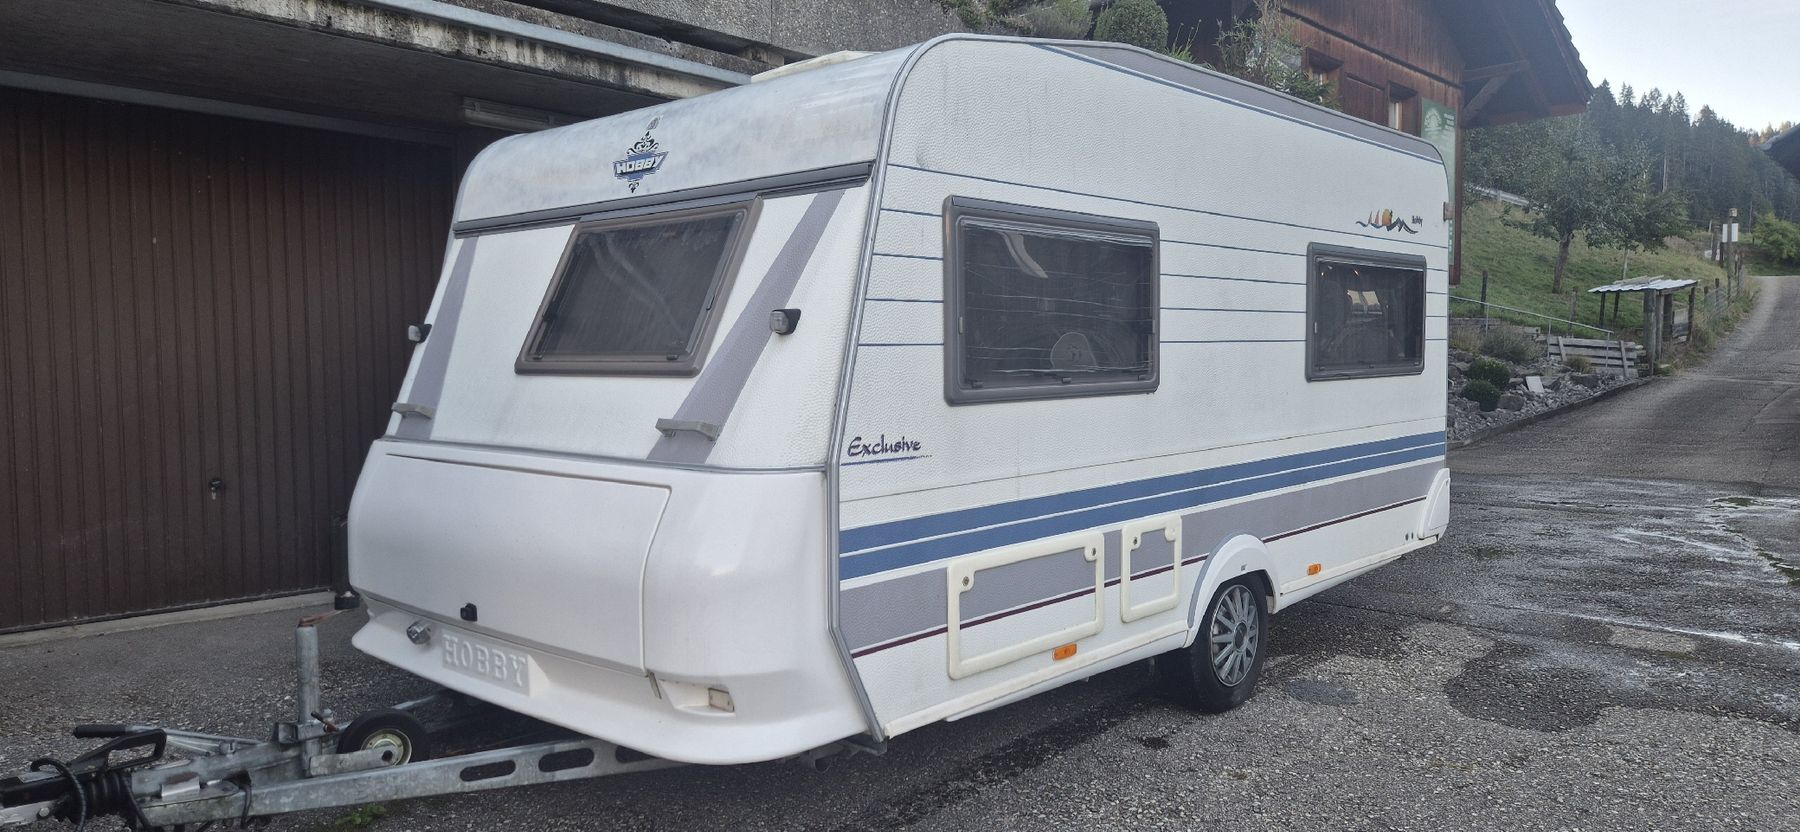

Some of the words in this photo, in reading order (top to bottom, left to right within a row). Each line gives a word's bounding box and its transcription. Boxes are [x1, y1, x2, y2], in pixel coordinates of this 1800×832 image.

[614, 154, 665, 174] HOBBY
[847, 434, 922, 457] Exclusive
[442, 634, 527, 687] HOBBY
